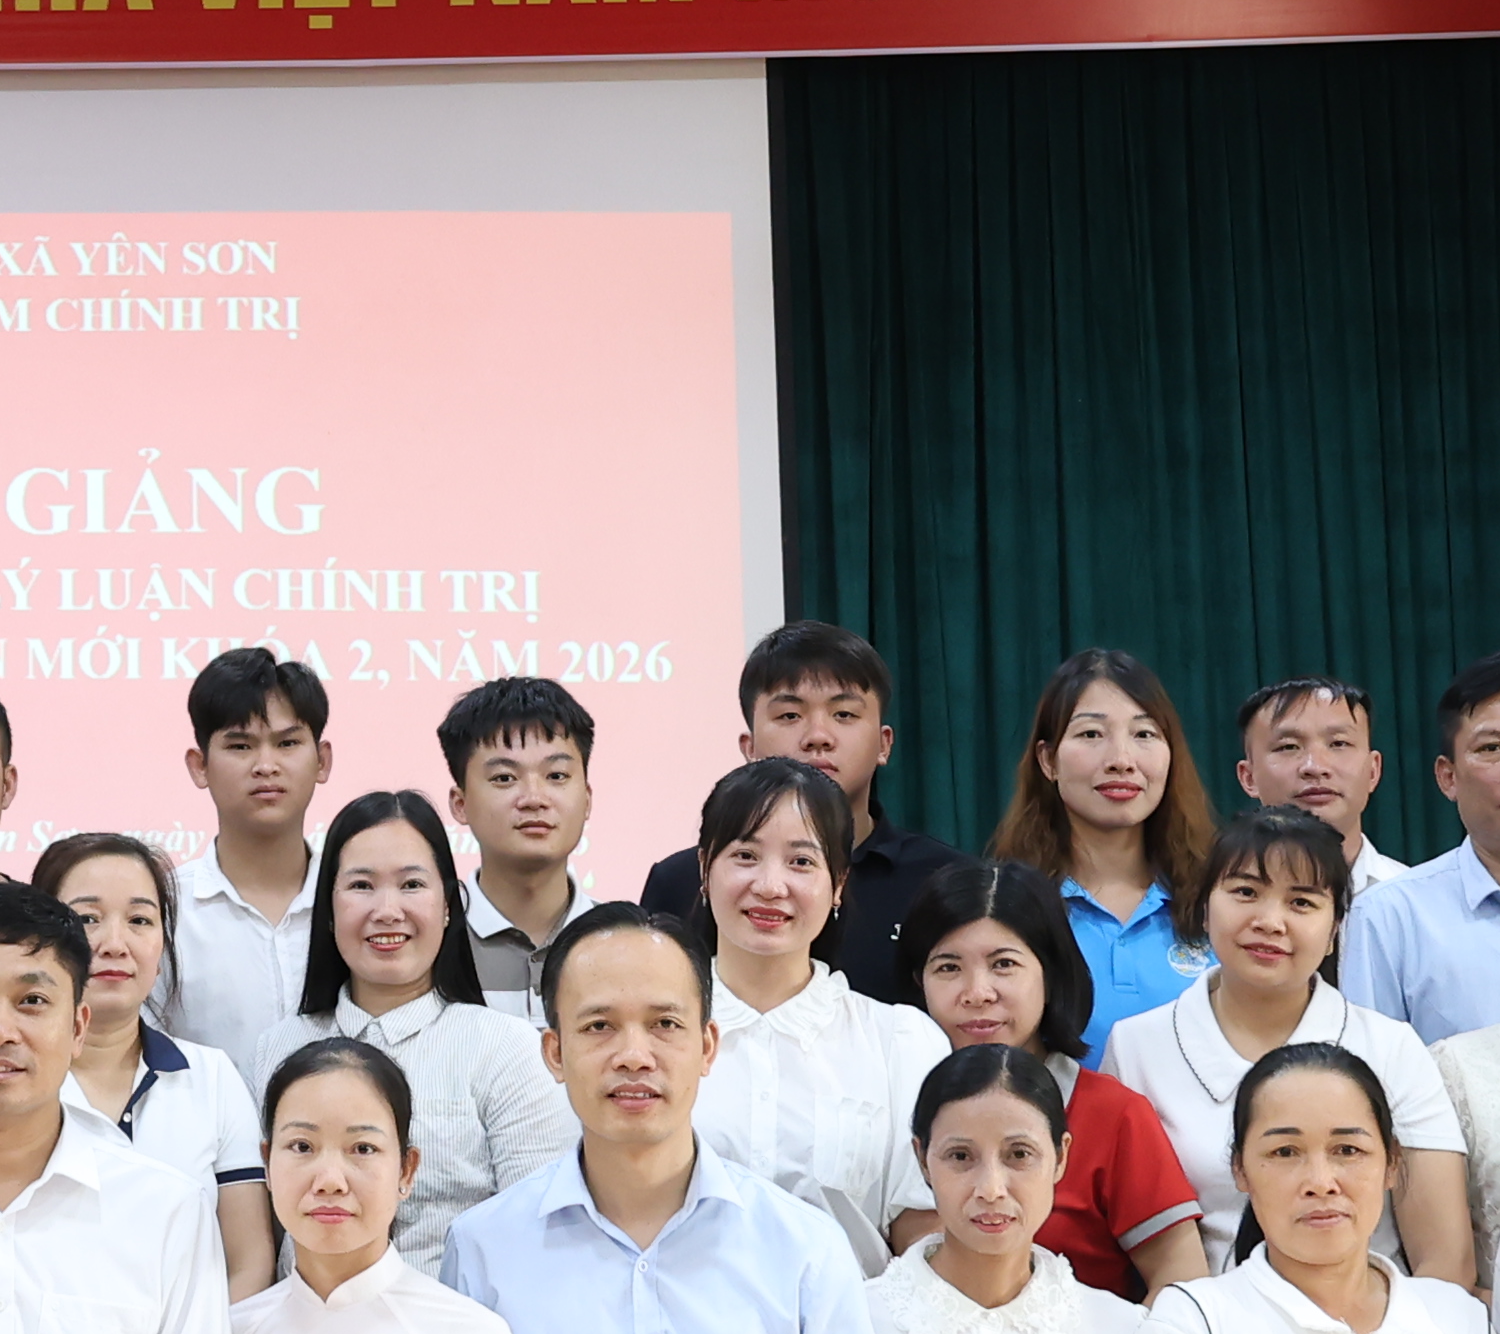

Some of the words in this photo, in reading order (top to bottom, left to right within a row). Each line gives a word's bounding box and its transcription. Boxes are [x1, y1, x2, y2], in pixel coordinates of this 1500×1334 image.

[70, 232, 169, 276] YÊN
[182, 239, 278, 275] SƠN
[46, 289, 206, 332] CHÍNH
[217, 297, 302, 340] TRỊ
[5, 448, 327, 535] GIẢNG
[57, 563, 217, 622] LUẬN
[233, 557, 427, 612] CHÍNH
[440, 569, 542, 624] TRỊ
[25, 625, 143, 680] MỚI
[348, 639, 392, 689] 2,
[405, 629, 542, 683] NĂM
[558, 640, 675, 685] 2026
